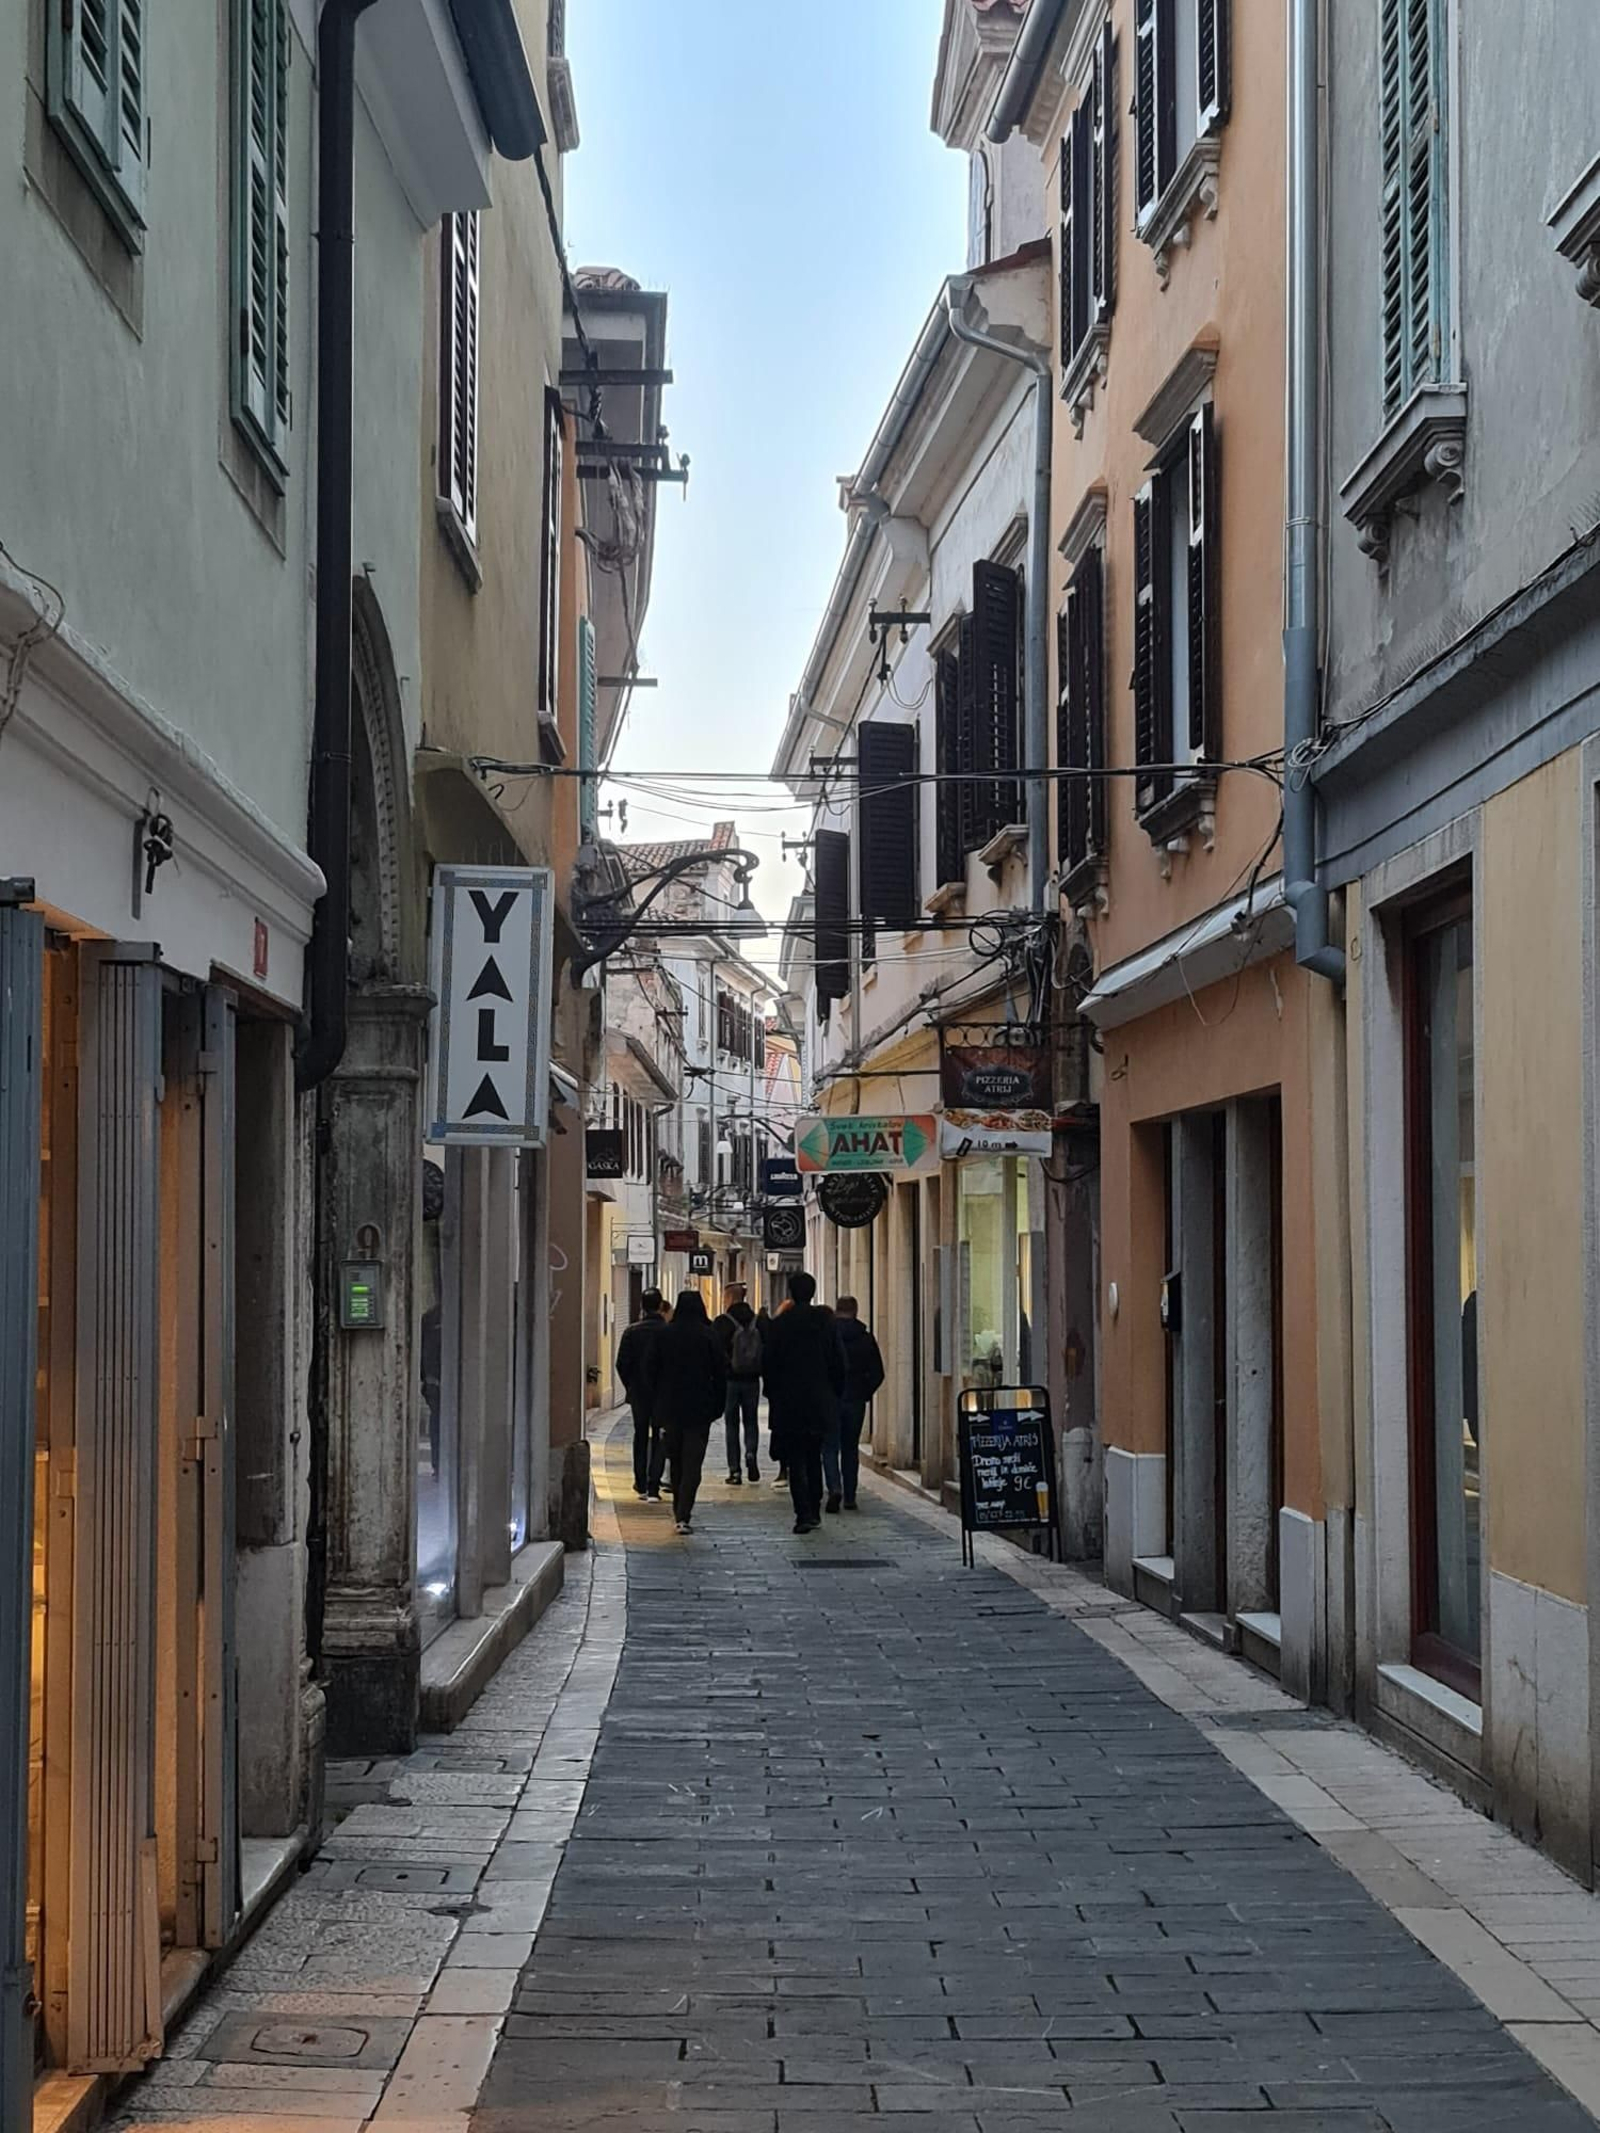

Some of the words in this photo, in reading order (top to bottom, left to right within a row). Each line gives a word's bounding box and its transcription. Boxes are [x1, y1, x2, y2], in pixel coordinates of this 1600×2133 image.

[461, 890, 519, 1121] YALA
[975, 1075, 1020, 1085] PIZZERIA
[984, 1085, 1012, 1093] ATRIJ
[830, 1131, 903, 1157] AHAT
[977, 1139, 988, 1149] 10
[693, 1255, 709, 1267] m
